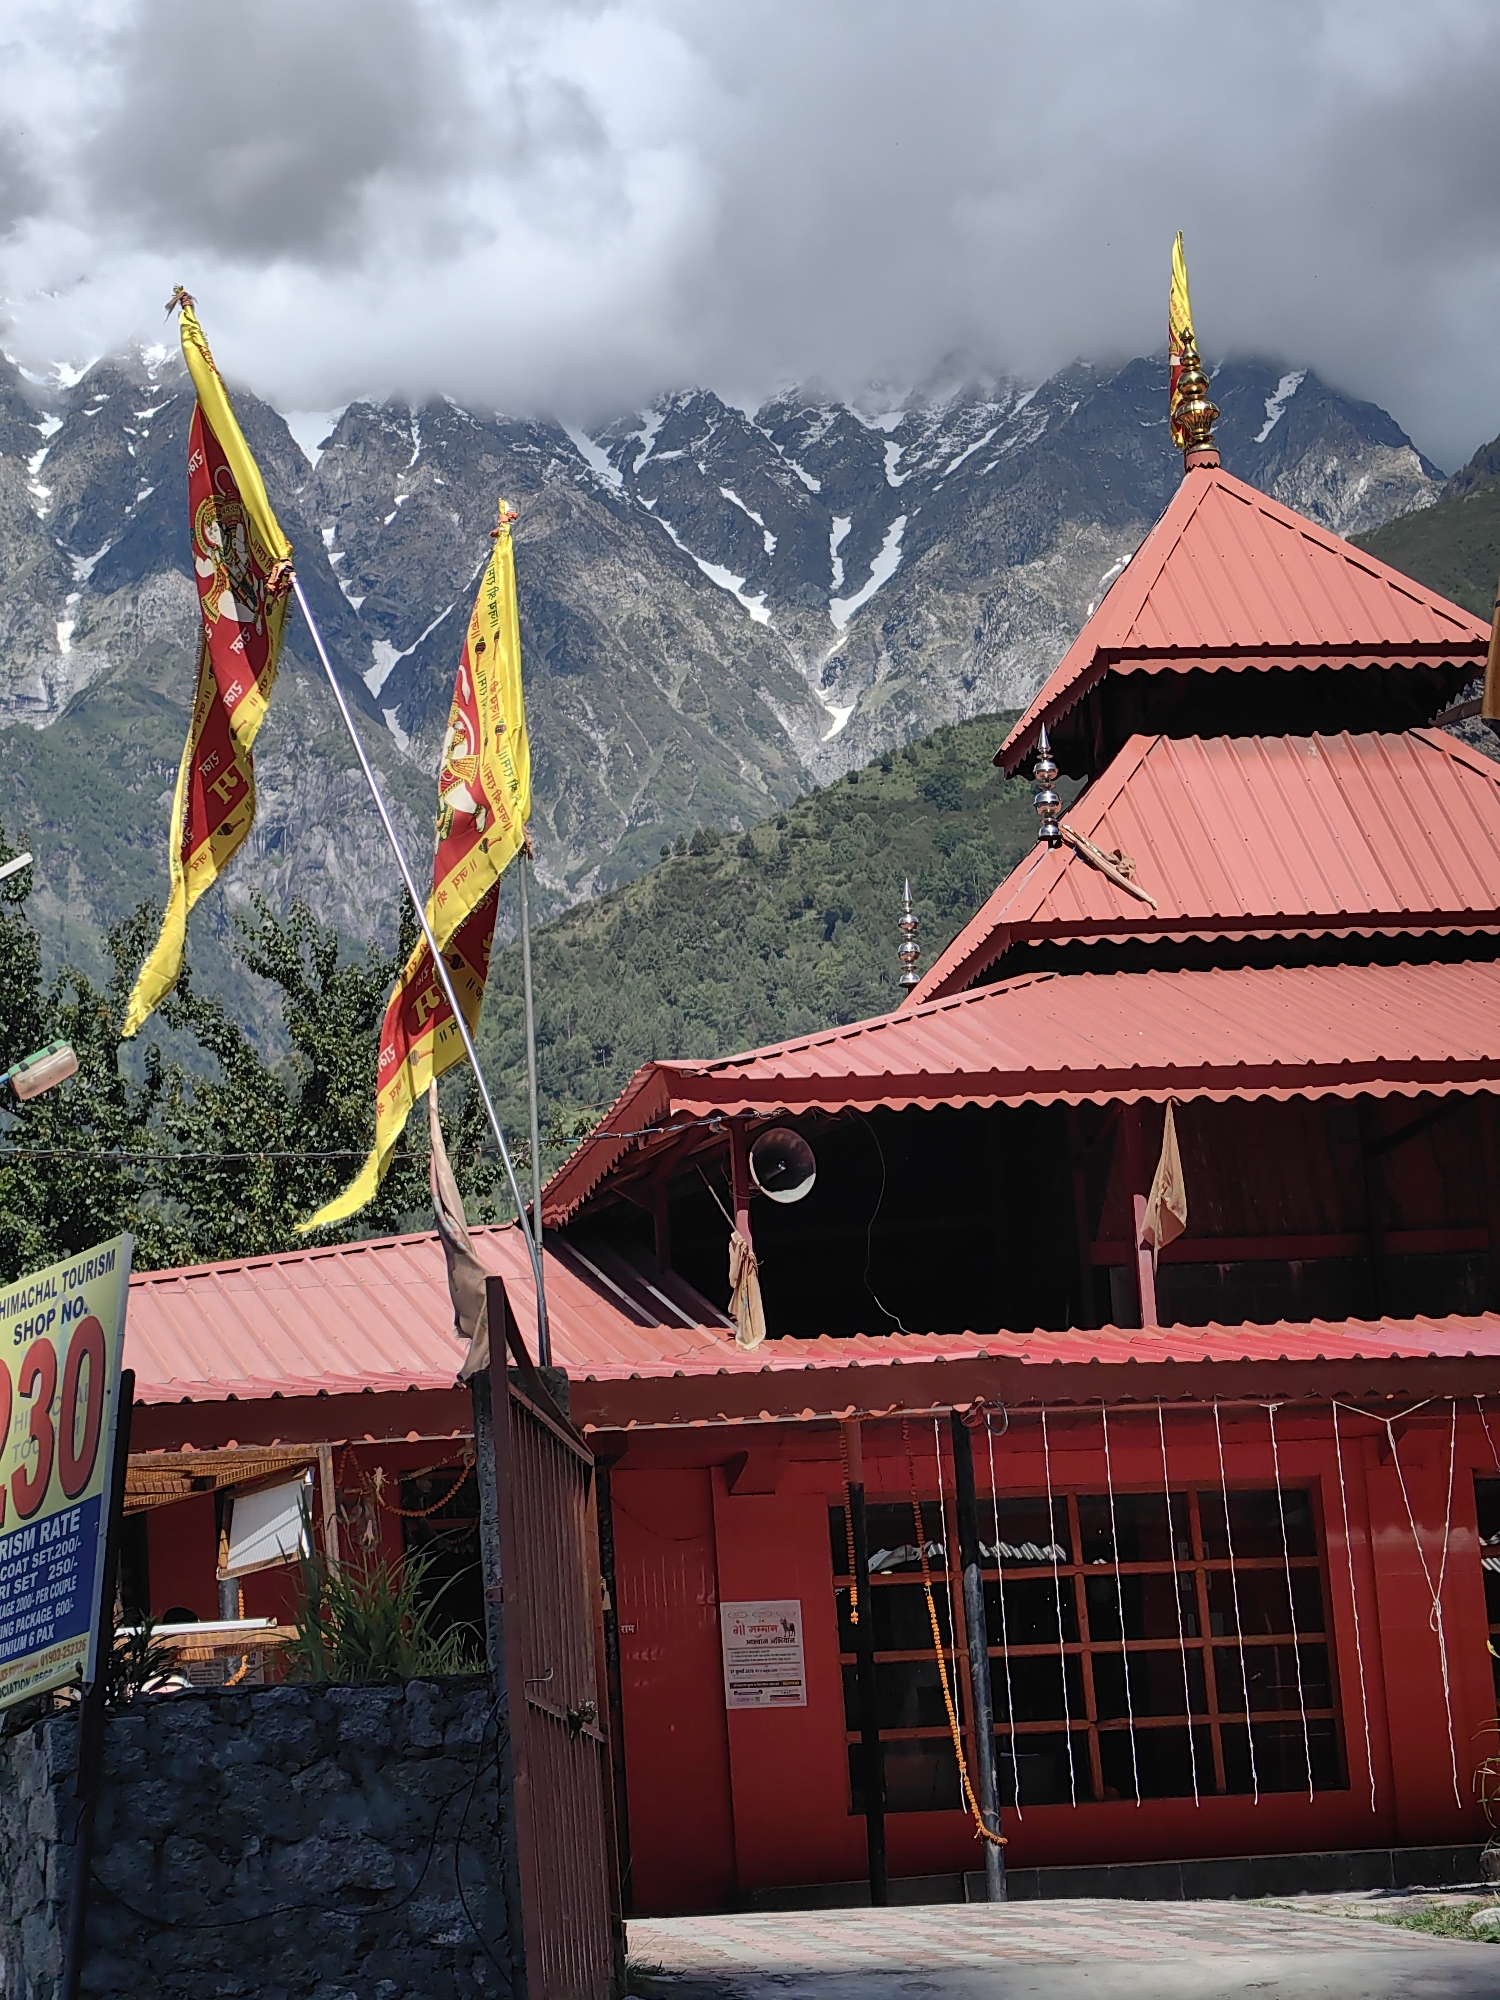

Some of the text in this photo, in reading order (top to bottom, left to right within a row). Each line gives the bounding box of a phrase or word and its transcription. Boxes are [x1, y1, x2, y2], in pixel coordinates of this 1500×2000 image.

[62, 1249, 116, 1293] TOURISM
[13, 1296, 88, 1346] SHOP NO.
[39, 1508, 81, 1545] RATE
[0, 1556, 29, 1581] COAT
[13, 1571, 38, 1595] SET
[47, 1556, 78, 1581] 250/-
[35, 1586, 49, 1605] PER
[49, 1575, 77, 1600] COUPLE
[28, 1631, 35, 1647] 6
[36, 1623, 54, 1644] PAX
